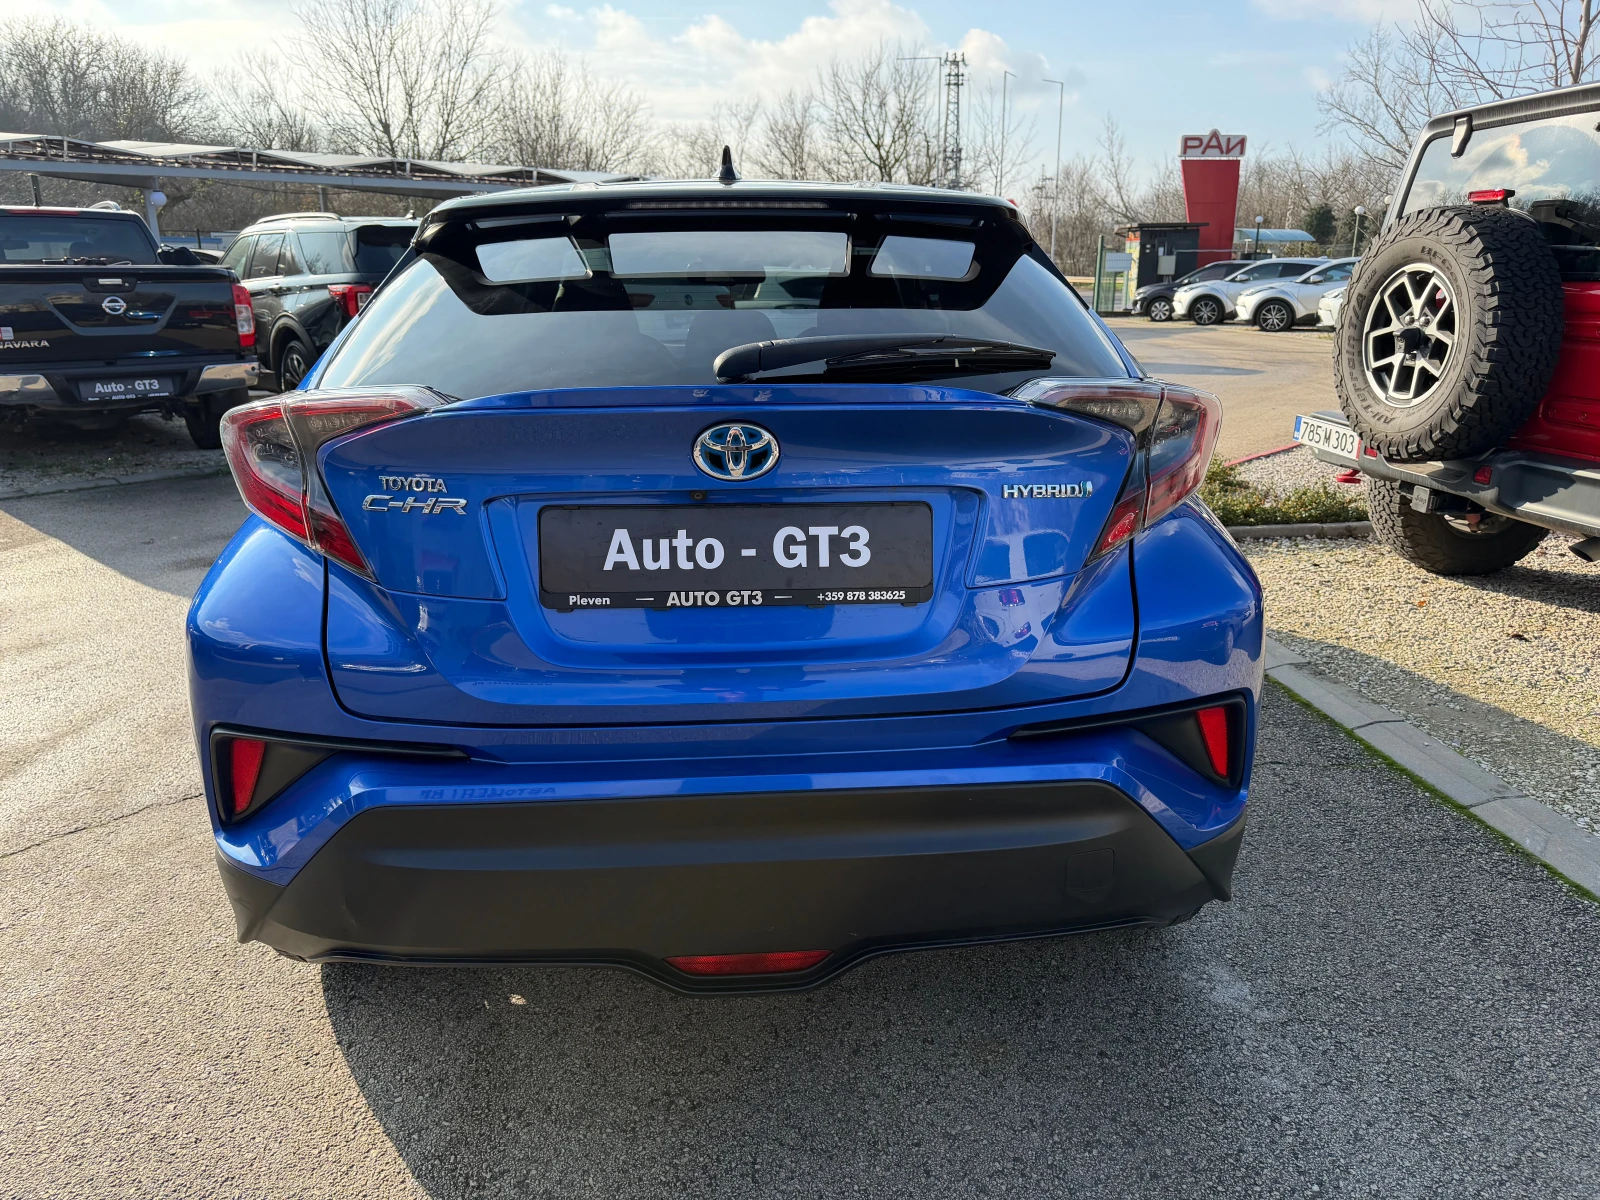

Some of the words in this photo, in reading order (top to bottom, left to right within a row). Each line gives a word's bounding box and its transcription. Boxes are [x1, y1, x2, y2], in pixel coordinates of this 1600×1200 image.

[95, 382, 125, 393] Auto
[134, 379, 159, 391] GT3
[379, 475, 448, 494] TOYOTA
[1003, 483, 1080, 499] HYBRID
[362, 494, 468, 515] C-HR
[603, 528, 724, 571] Auto
[772, 525, 871, 569] GT3
[569, 594, 611, 606] Pleven
[666, 591, 720, 607] AUTO
[725, 590, 763, 605] GT3
[817, 591, 844, 602] +359
[846, 590, 865, 601] 878
[867, 590, 906, 601] 383625
